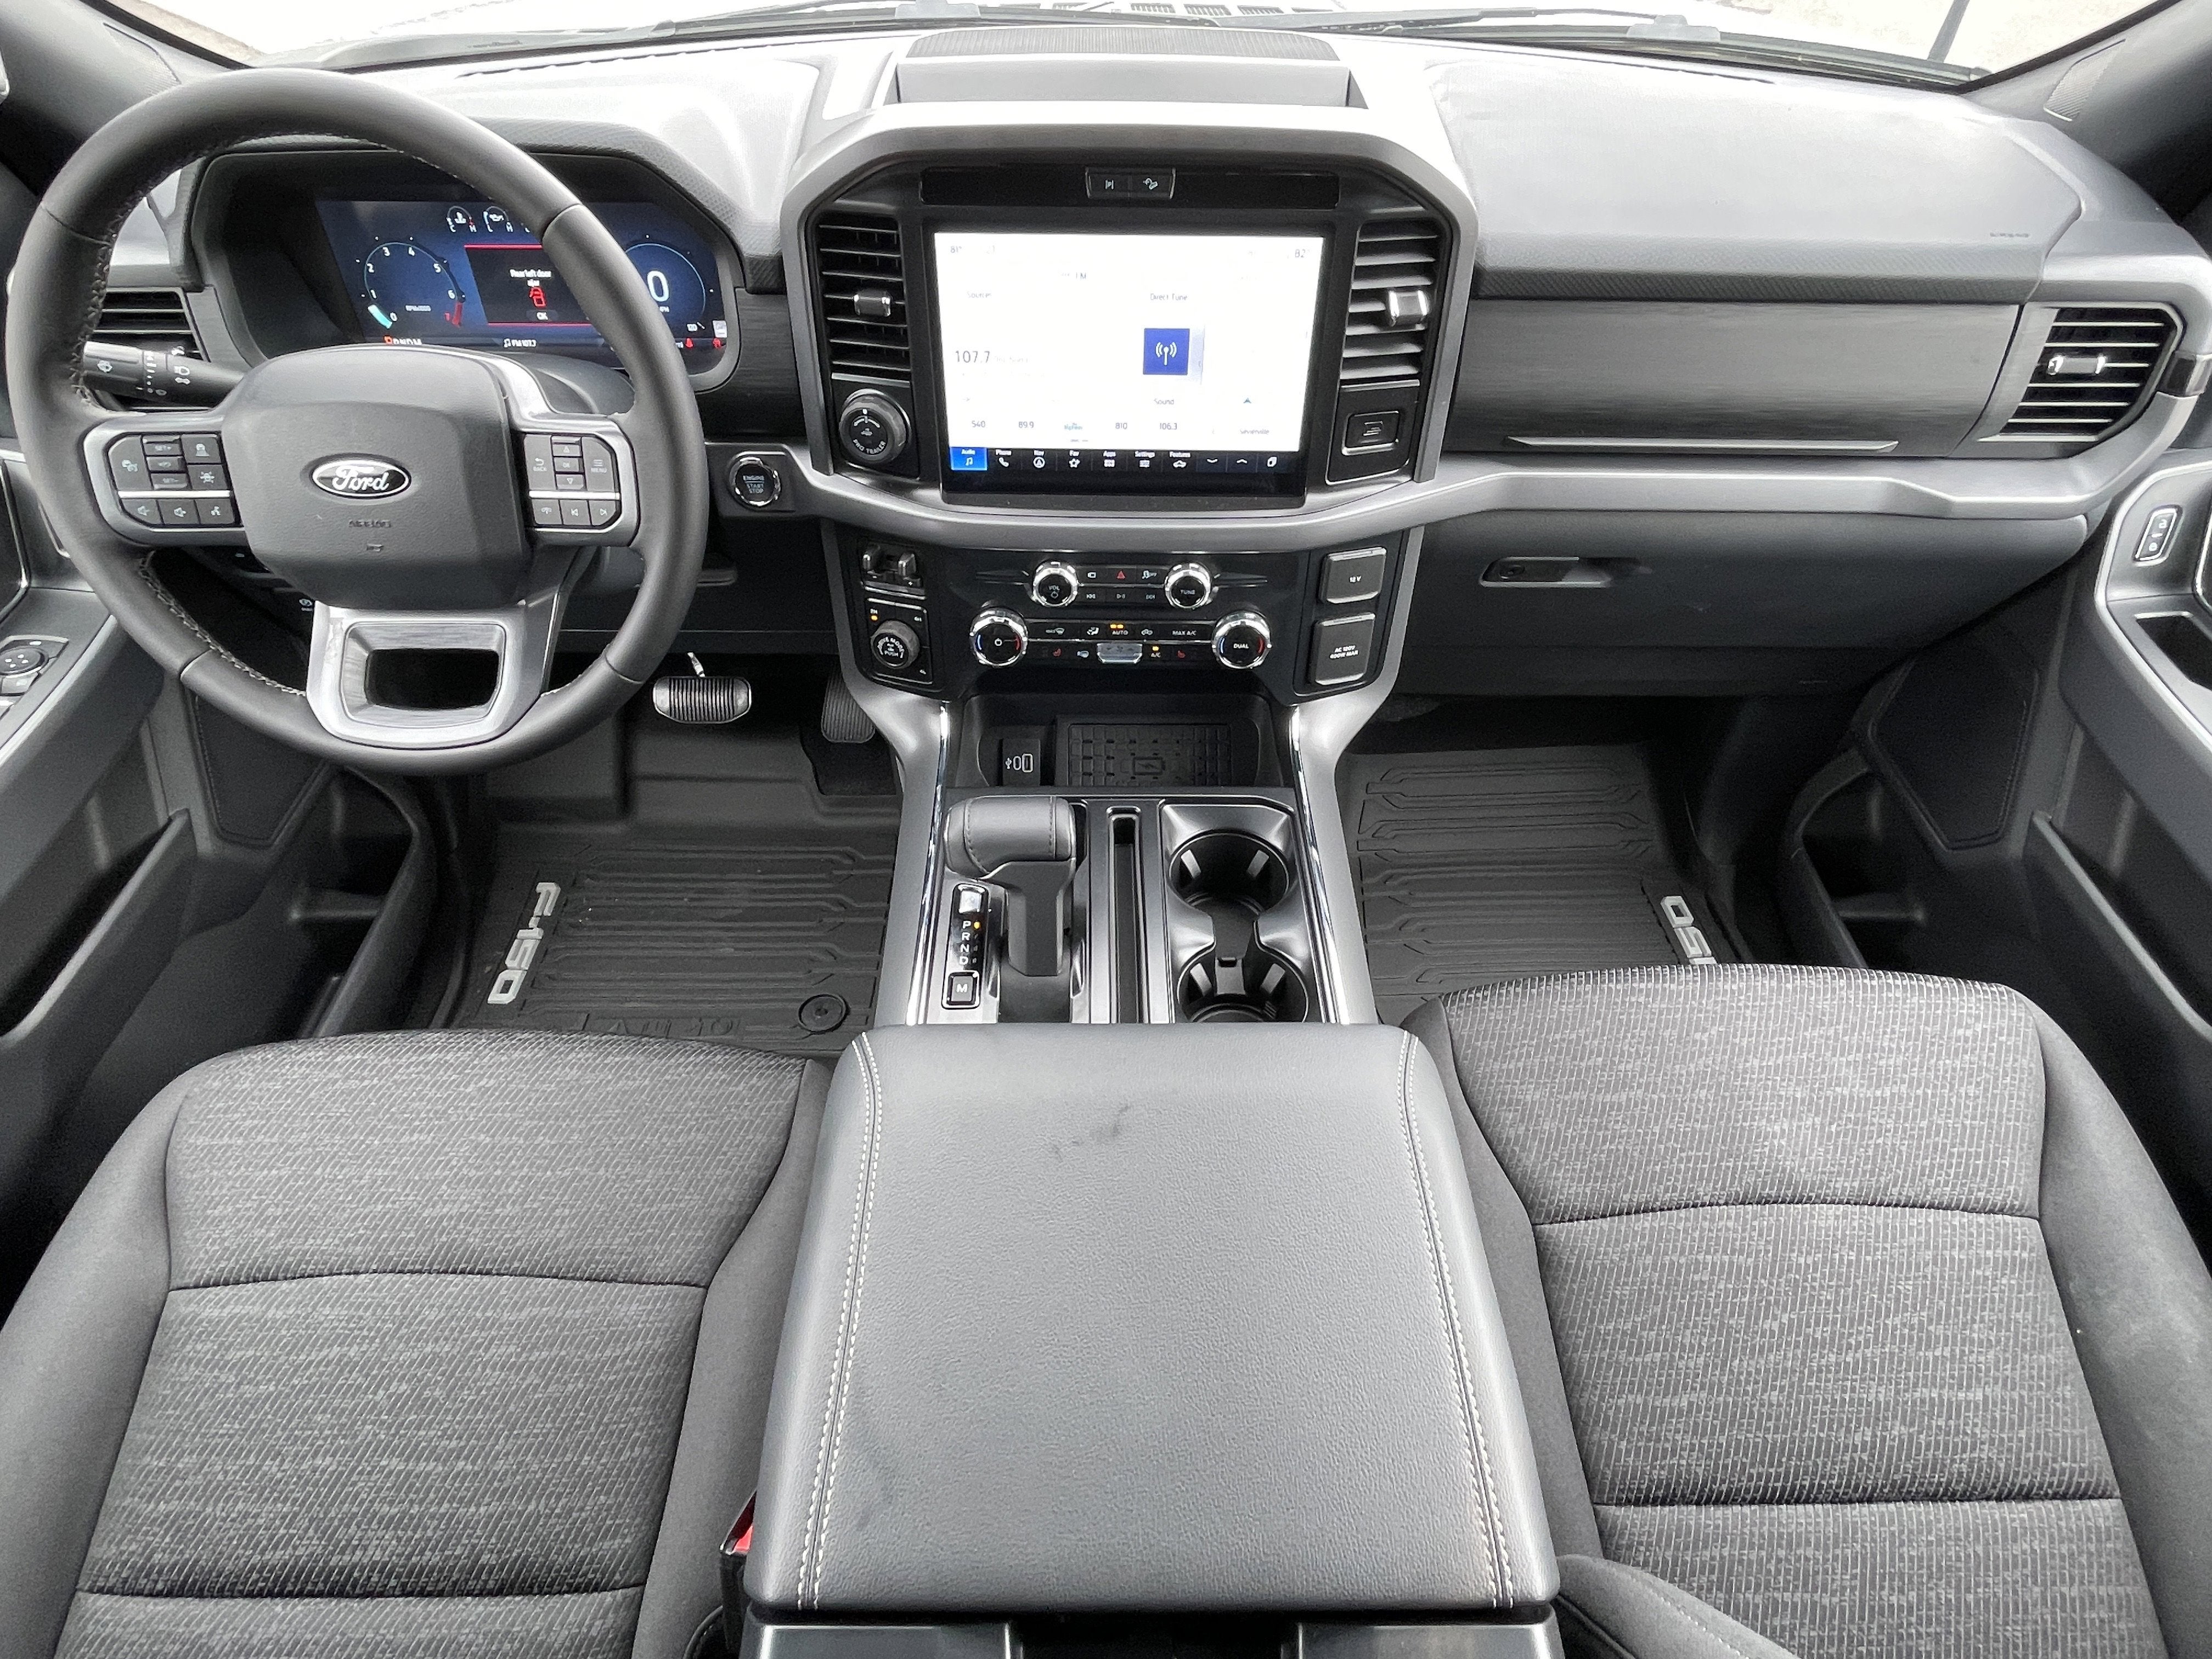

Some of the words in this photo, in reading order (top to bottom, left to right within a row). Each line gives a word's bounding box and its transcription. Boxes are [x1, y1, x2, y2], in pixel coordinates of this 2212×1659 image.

[383, 247, 390, 256] 3
[408, 247, 415, 256] 4
[366, 263, 374, 273] 2
[433, 263, 441, 273] 5
[646, 270, 670, 302] 0
[370, 289, 377, 298] 1
[448, 289, 455, 299] 6
[390, 312, 398, 321] 0
[955, 350, 990, 363] 107.7
[332, 466, 390, 490] Ford
[962, 921, 971, 929] P
[961, 932, 970, 941] R
[487, 882, 561, 1005] F-150
[960, 944, 969, 953] N
[960, 956, 969, 965] D
[956, 984, 968, 993] M
